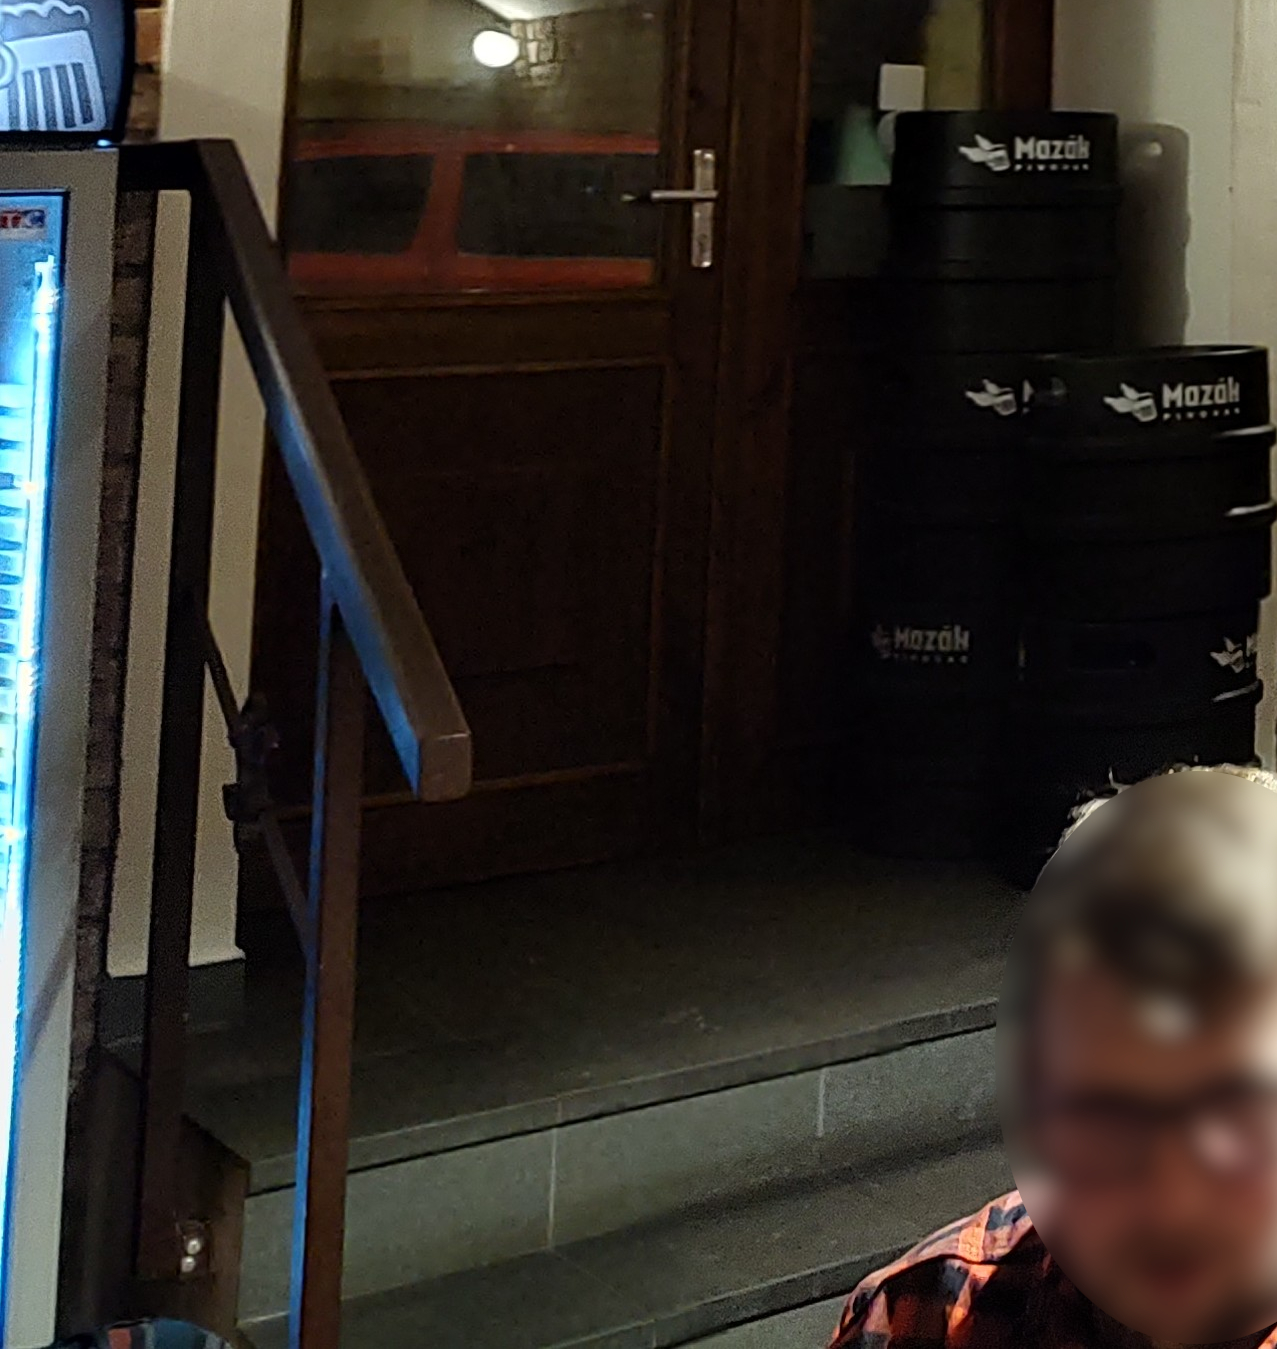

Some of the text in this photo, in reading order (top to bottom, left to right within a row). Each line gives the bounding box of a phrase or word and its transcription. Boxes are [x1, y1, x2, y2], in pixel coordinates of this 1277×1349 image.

[1014, 134, 1090, 160] Mazák
[1162, 376, 1241, 409] Mazák
[894, 624, 971, 652] Mazák
